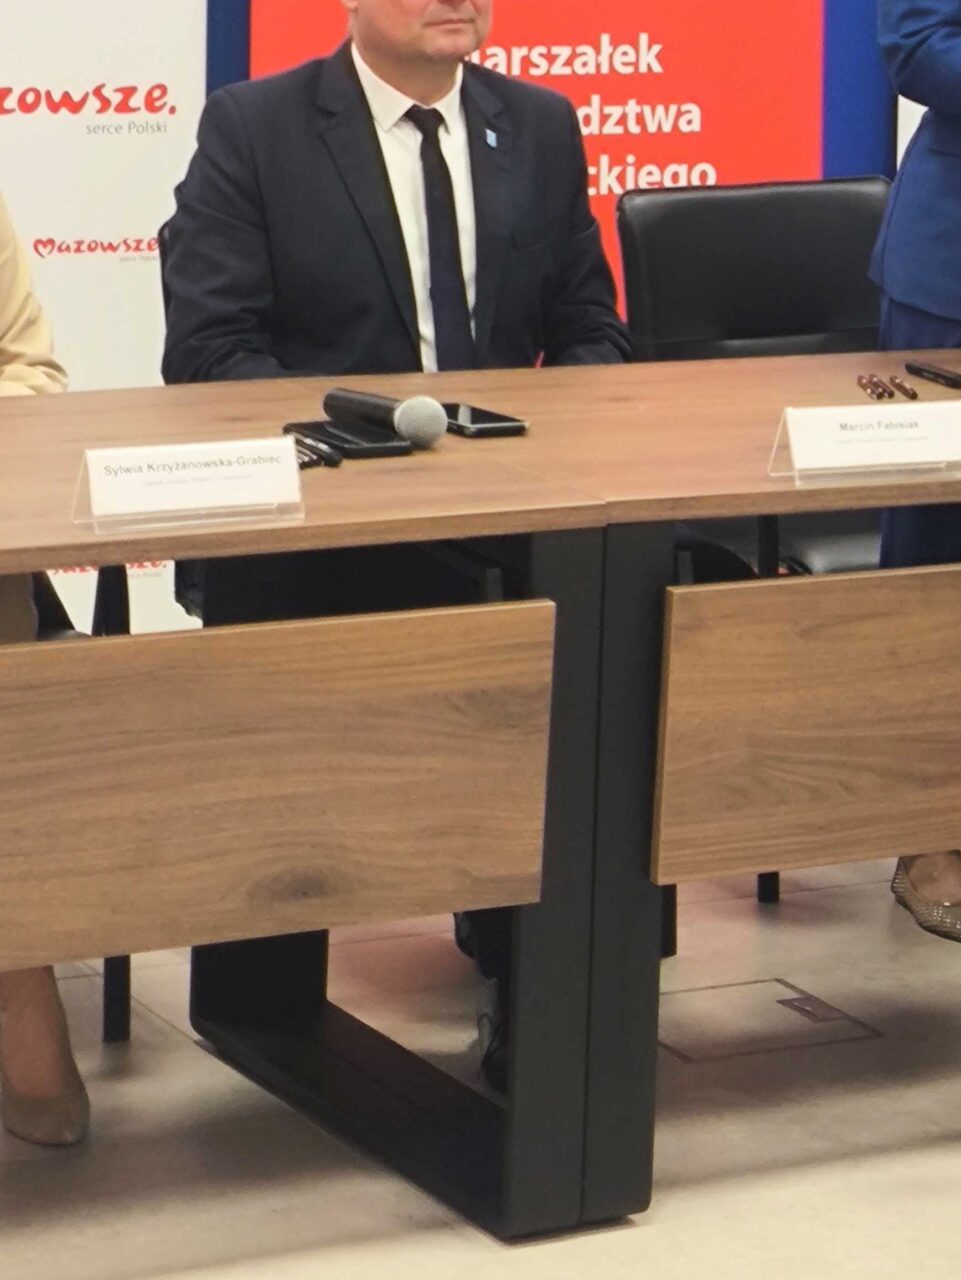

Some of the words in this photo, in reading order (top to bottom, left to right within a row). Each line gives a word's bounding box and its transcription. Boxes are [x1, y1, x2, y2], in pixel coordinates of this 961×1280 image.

[86, 123, 124, 135] serce
[128, 121, 167, 135] Polski
[103, 464, 144, 478] Sylwia
